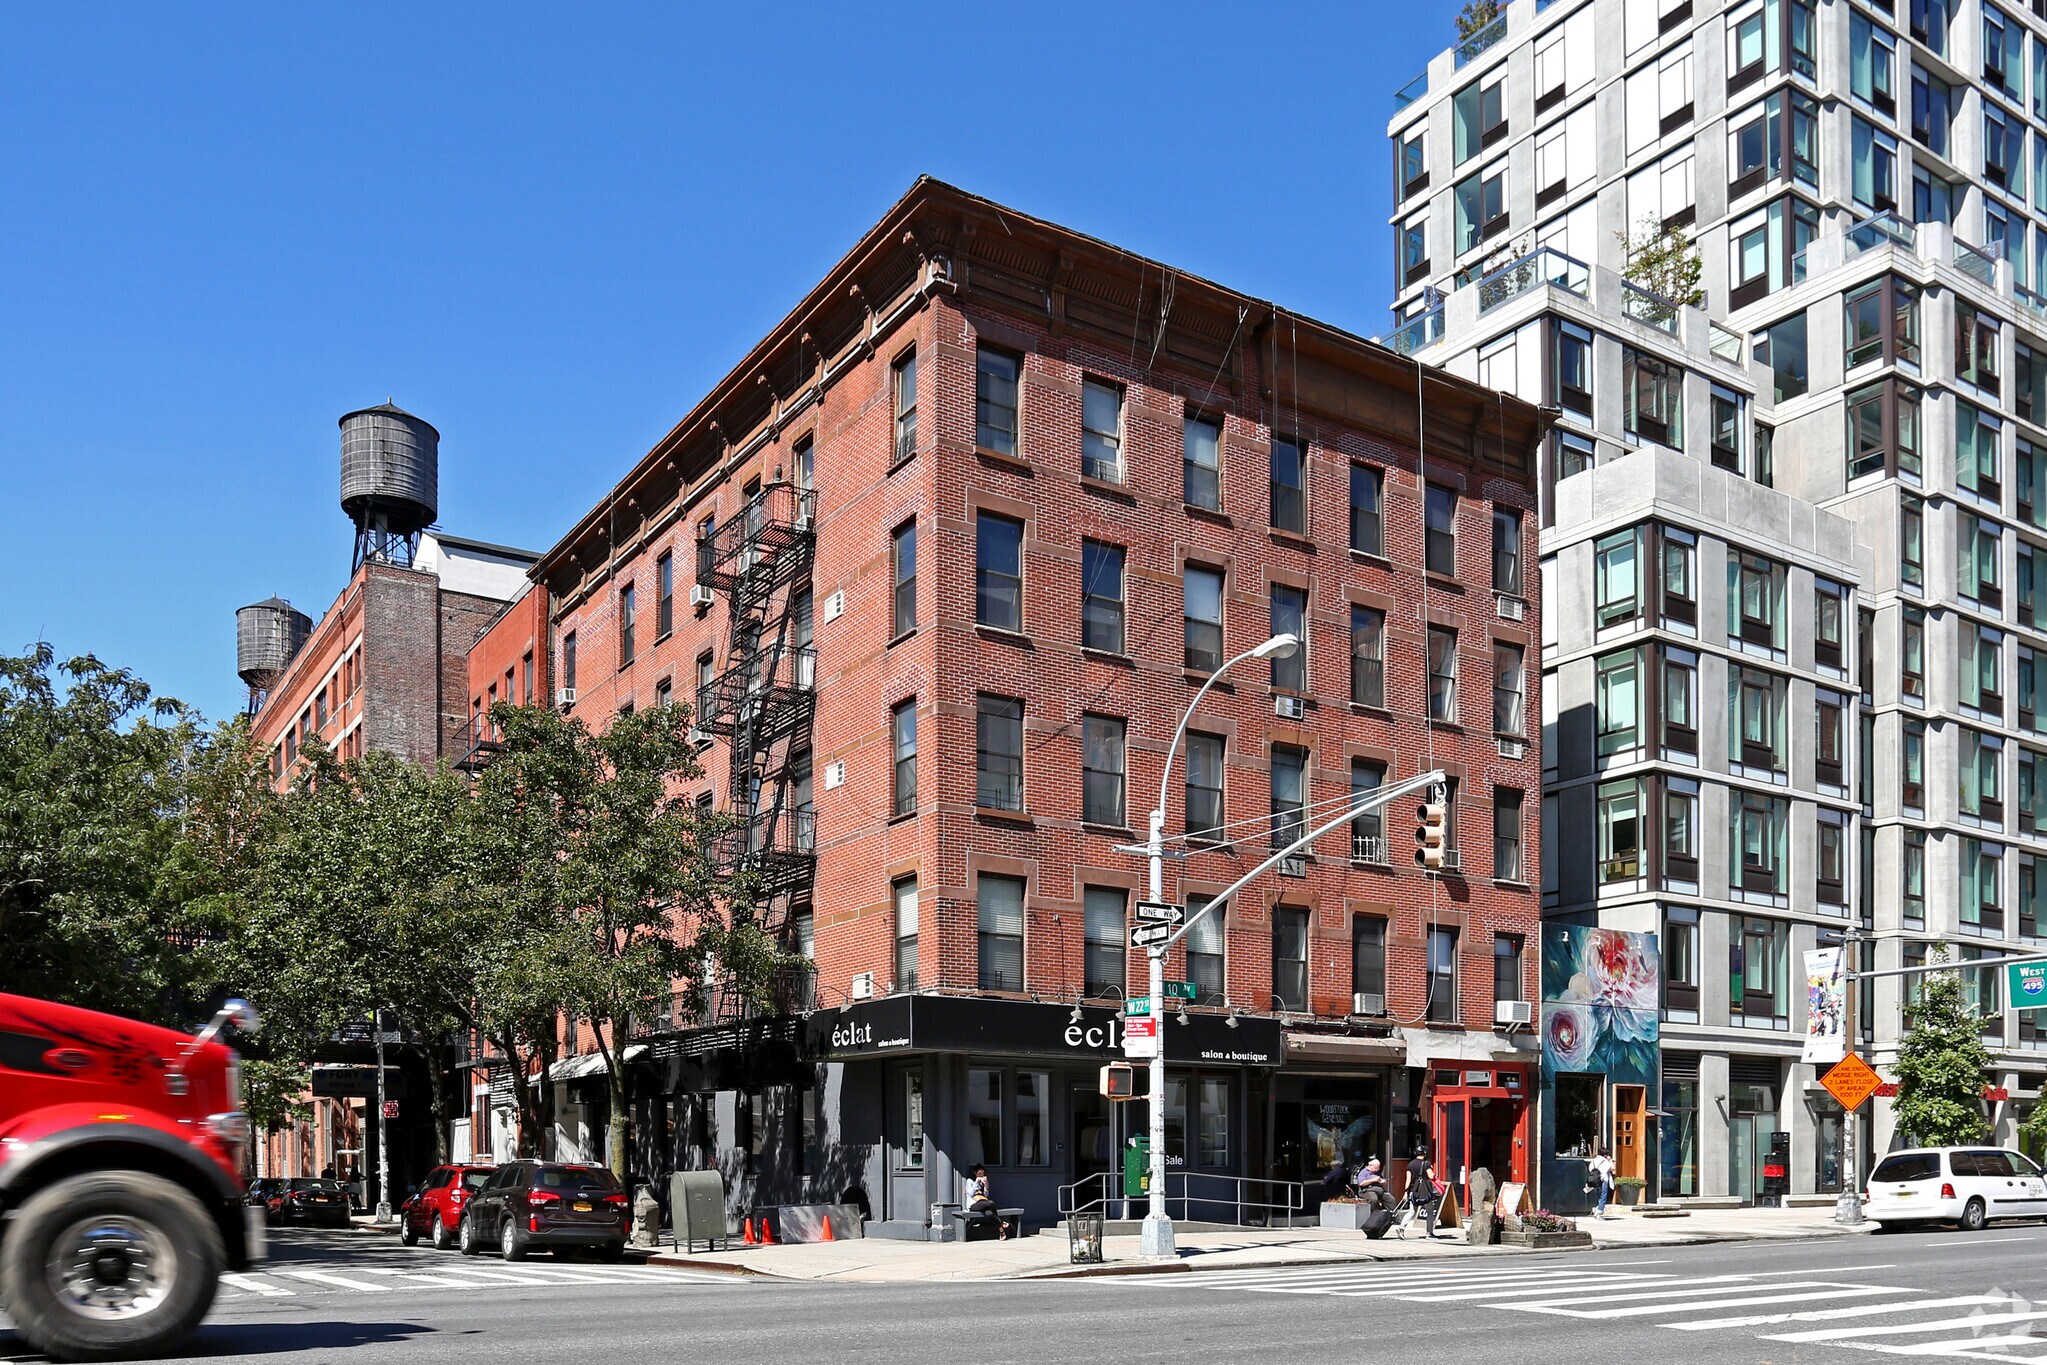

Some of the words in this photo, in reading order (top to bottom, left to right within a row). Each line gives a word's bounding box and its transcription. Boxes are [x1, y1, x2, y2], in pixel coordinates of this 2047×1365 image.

[1143, 907, 1158, 916] ONE
[1163, 910, 1178, 919] WAY
[1136, 932, 1147, 940] ONE
[1151, 928, 1165, 937] WAY
[1167, 983, 1178, 995] 10
[2023, 981, 2044, 991] 495
[1127, 1001, 1136, 1014] W
[1135, 1000, 1145, 1013] 22
[832, 1021, 872, 1047] éclat
[1064, 1017, 1127, 1049] écl
[1201, 1050, 1224, 1060] salon
[1231, 1051, 1268, 1062] boutique
[1165, 1154, 1183, 1165] Sale
